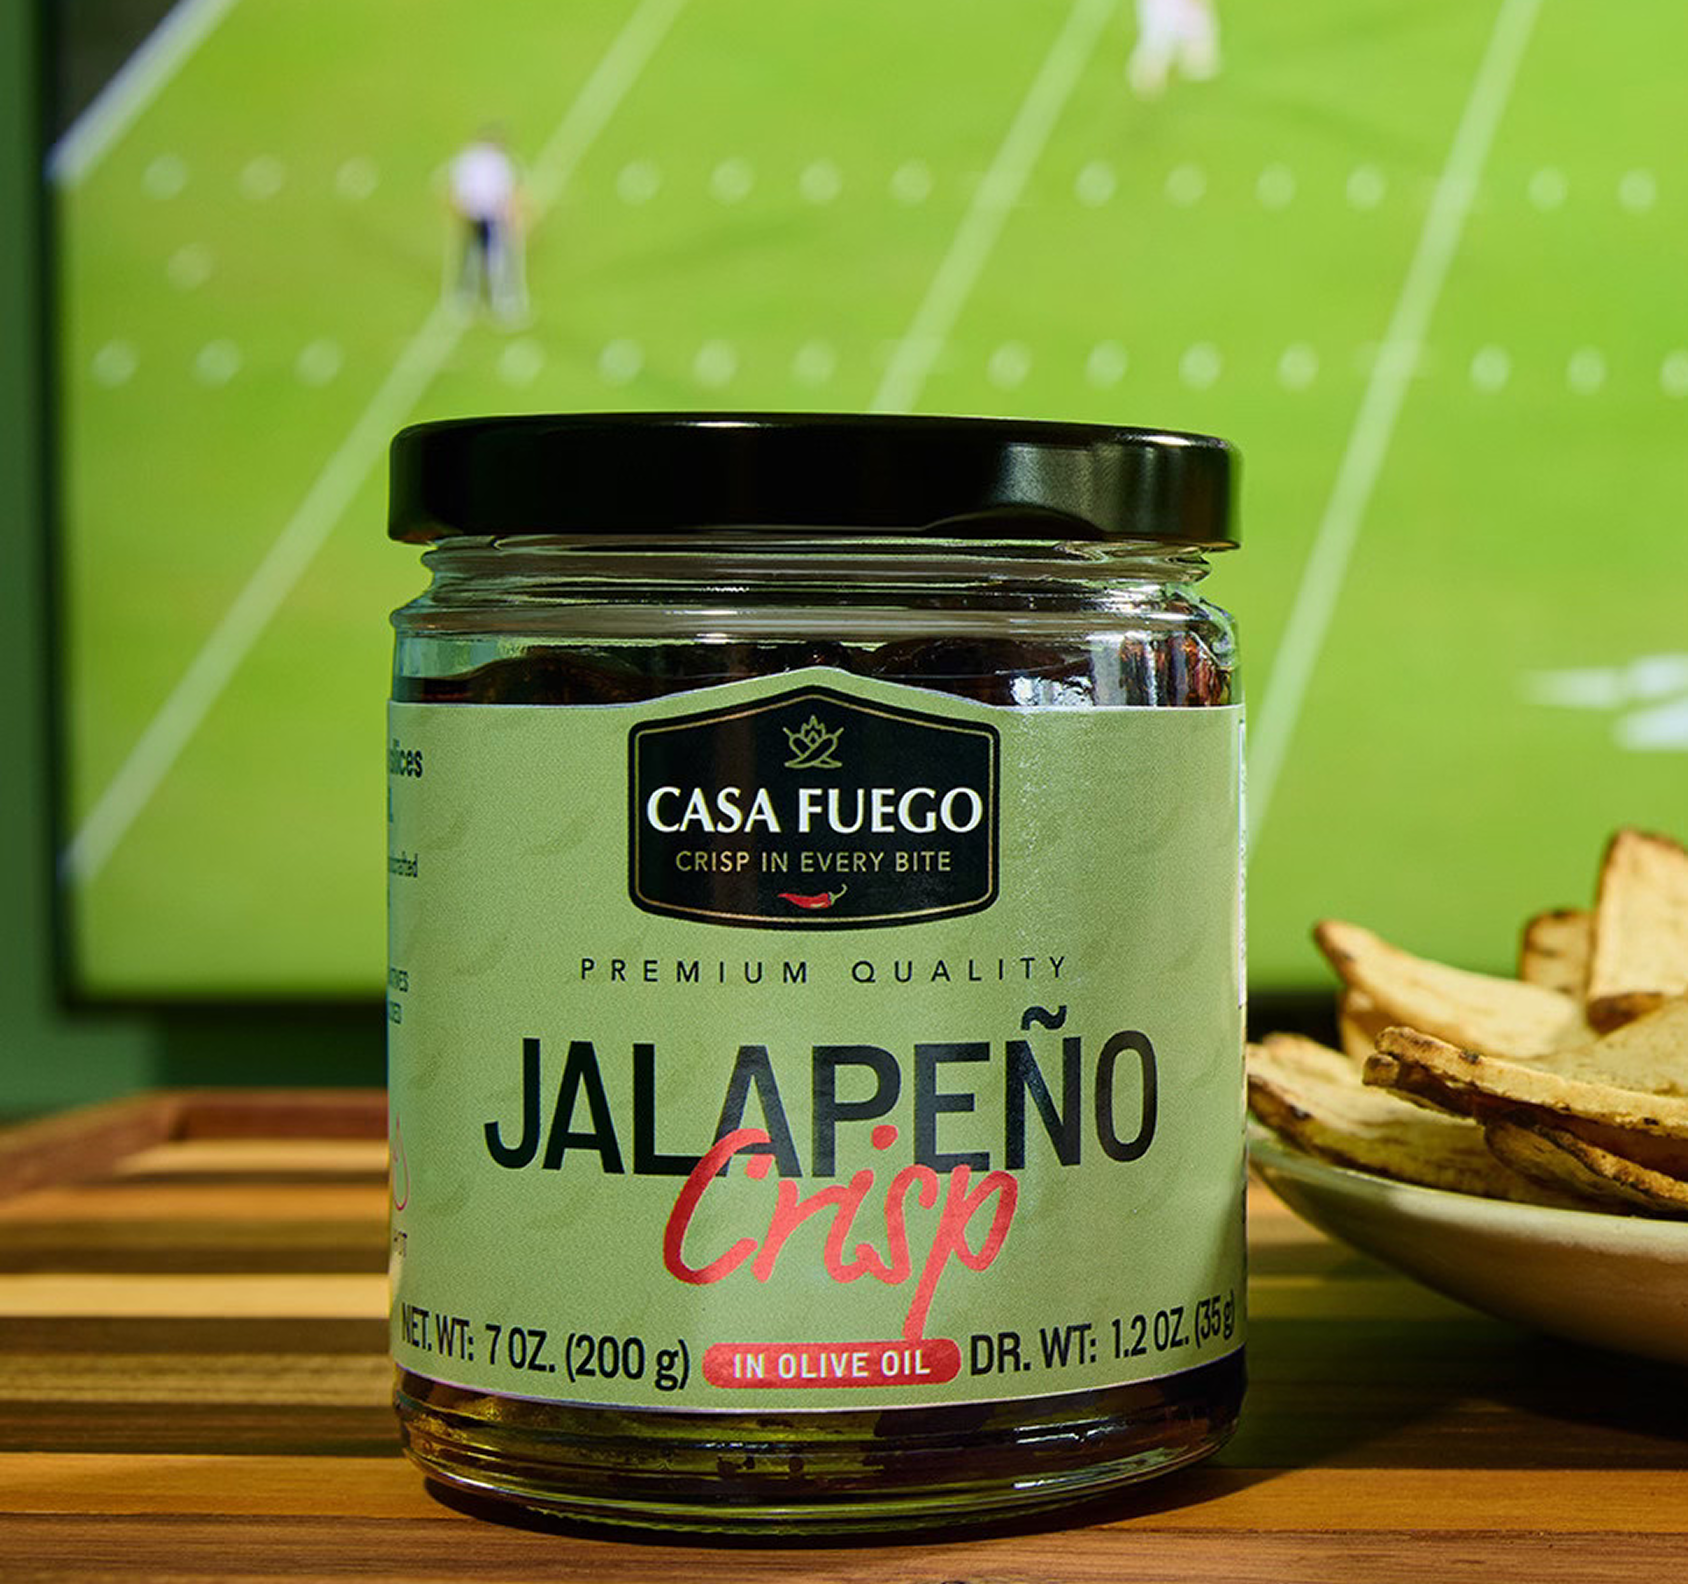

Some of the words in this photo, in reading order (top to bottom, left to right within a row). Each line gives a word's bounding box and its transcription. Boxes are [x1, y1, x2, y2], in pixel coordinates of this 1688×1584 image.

[646, 786, 782, 834] CASA
[798, 786, 984, 834] FUEGO
[675, 850, 751, 873] CRISP
[761, 851, 789, 873] IN
[800, 851, 885, 873] EVERY
[895, 850, 952, 872] BITE
[581, 957, 808, 984] PREMIUM
[851, 956, 1067, 984] QUALITY
[484, 1004, 1159, 1178] JALAPEÑO
[662, 1124, 1019, 1341] Crisp
[402, 1302, 432, 1351] NET.
[435, 1313, 474, 1361] WT:
[485, 1324, 502, 1366] 7
[508, 1327, 556, 1374] OZ.
[565, 1332, 646, 1383] (200
[655, 1338, 691, 1391] g)
[732, 1353, 765, 1379] IN
[777, 1351, 870, 1379] OLIVE
[881, 1350, 931, 1375] OIL
[969, 1332, 1031, 1376] DR.
[1040, 1322, 1097, 1369] WT:
[1111, 1315, 1149, 1359] 1.2
[1154, 1306, 1190, 1352] OZ.
